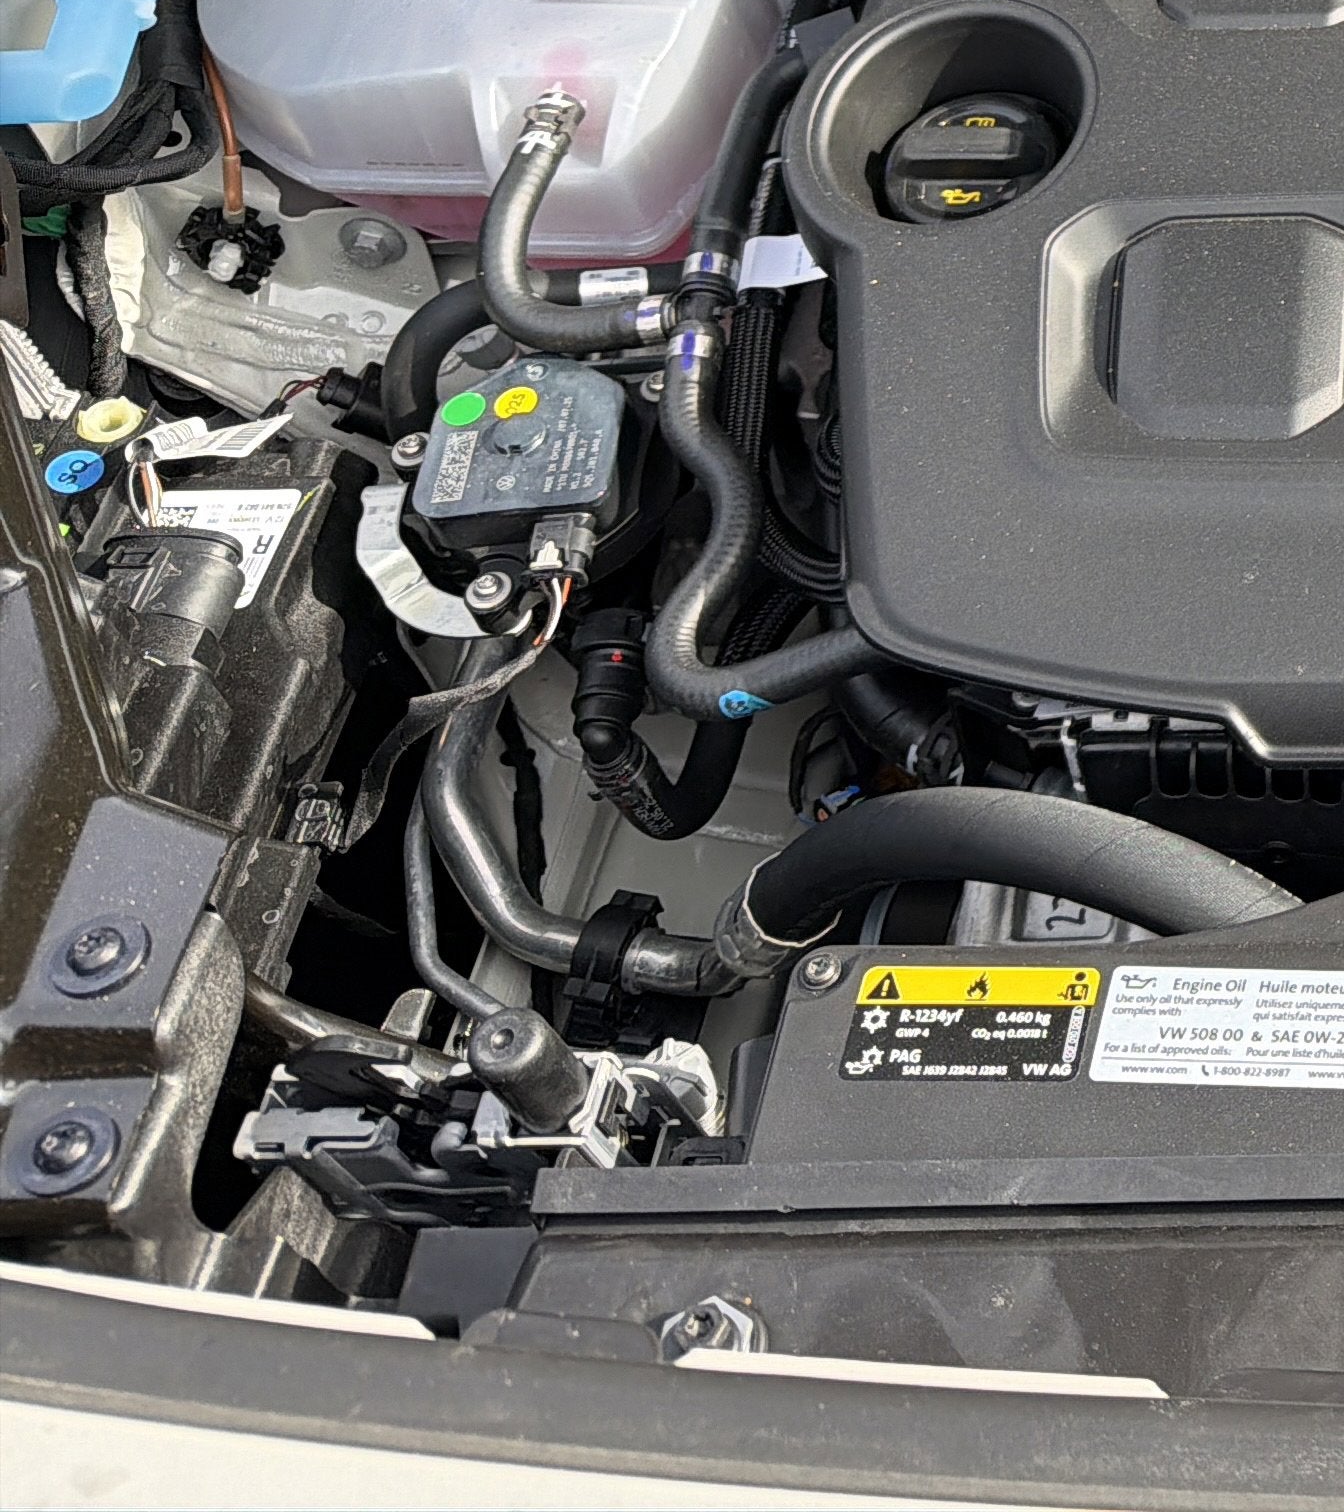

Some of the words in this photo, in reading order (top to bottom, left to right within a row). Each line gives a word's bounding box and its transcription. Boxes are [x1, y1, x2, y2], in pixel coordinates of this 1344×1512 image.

[252, 535, 275, 555] R
[1173, 978, 1224, 995] Engine
[1225, 979, 1248, 993] Oil
[1258, 981, 1298, 994] Huile
[1115, 994, 1135, 1004] Use
[1136, 994, 1159, 1007] only
[1159, 994, 1173, 1005] oil
[1173, 995, 1195, 1006] that
[1195, 996, 1244, 1010] expressly
[1255, 999, 1294, 1010] Utilisez
[899, 1008, 965, 1026] R-1234yf
[996, 1011, 1034, 1024] 0.460
[1035, 1011, 1052, 1027] kg
[1112, 1006, 1157, 1018] complies
[1158, 1007, 1183, 1017] with
[1252, 1011, 1271, 1023] qui
[1271, 1012, 1312, 1022] satisfait
[895, 1028, 922, 1039] GWP
[922, 1028, 931, 1038] 4
[992, 1030, 1005, 1041] eq
[1006, 1029, 1041, 1039] 0.0018
[1042, 1029, 1049, 1039] t
[1159, 1026, 1188, 1040] VW
[1189, 1027, 1219, 1041] 508
[1222, 1028, 1245, 1042] 00
[1251, 1031, 1264, 1042] &
[1271, 1030, 1301, 1044] SAE
[889, 1049, 923, 1063] PAG
[1103, 1042, 1121, 1053] For
[1121, 1044, 1129, 1053] a
[1130, 1043, 1147, 1054] list
[1147, 1043, 1161, 1055] of
[1161, 1045, 1209, 1057] approved
[1210, 1045, 1233, 1057] oils:
[1245, 1047, 1270, 1058] Pour
[1271, 1048, 1291, 1058] une
[1292, 1048, 1312, 1059] liste
[902, 1065, 922, 1077] SAE
[923, 1065, 947, 1077] J639
[947, 1065, 978, 1077] J2842
[1022, 1063, 1049, 1077] VW
[1049, 1063, 1073, 1077] AG
[1121, 1066, 1189, 1076] www.vw.com
